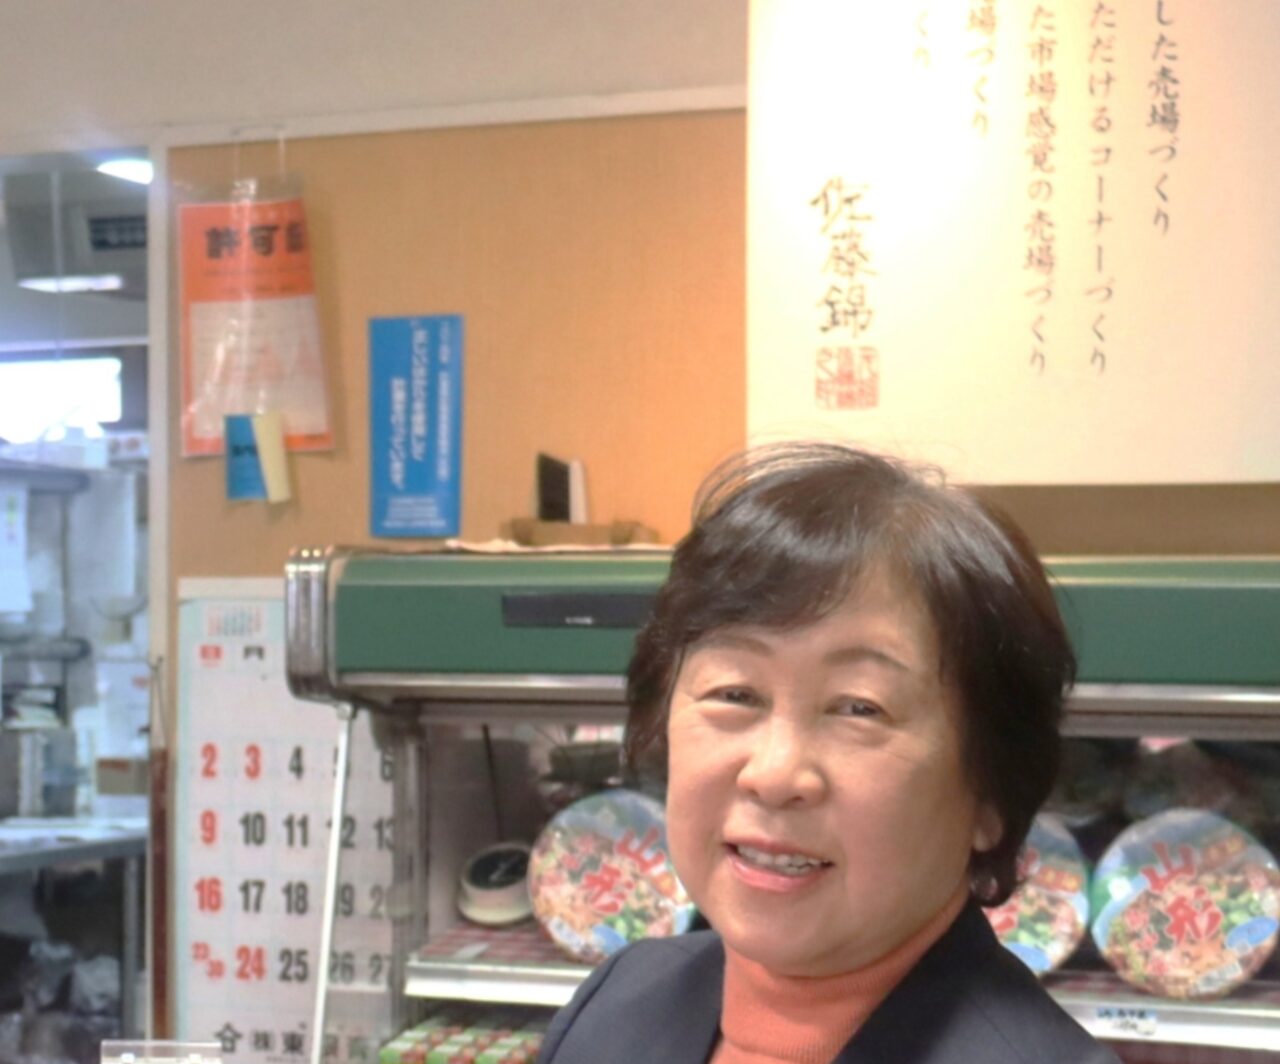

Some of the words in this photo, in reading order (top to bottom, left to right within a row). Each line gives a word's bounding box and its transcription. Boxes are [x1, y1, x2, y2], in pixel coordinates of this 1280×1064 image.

[1023, 4, 1057, 376] た市場感覚の売場づくり
[1084, 2, 1117, 376] ただけるコーナーづくり
[809, 177, 878, 338] 佐藤錦
[201, 744, 217, 779] 2
[245, 745, 261, 779] 3
[288, 746, 304, 780] 4
[200, 810, 216, 845] 9
[239, 812, 265, 846] 10
[283, 815, 310, 848] 11
[195, 877, 222, 911] 16
[239, 880, 265, 914] 17
[282, 882, 309, 915] 18
[235, 945, 266, 981] 24
[279, 948, 309, 983] 25
